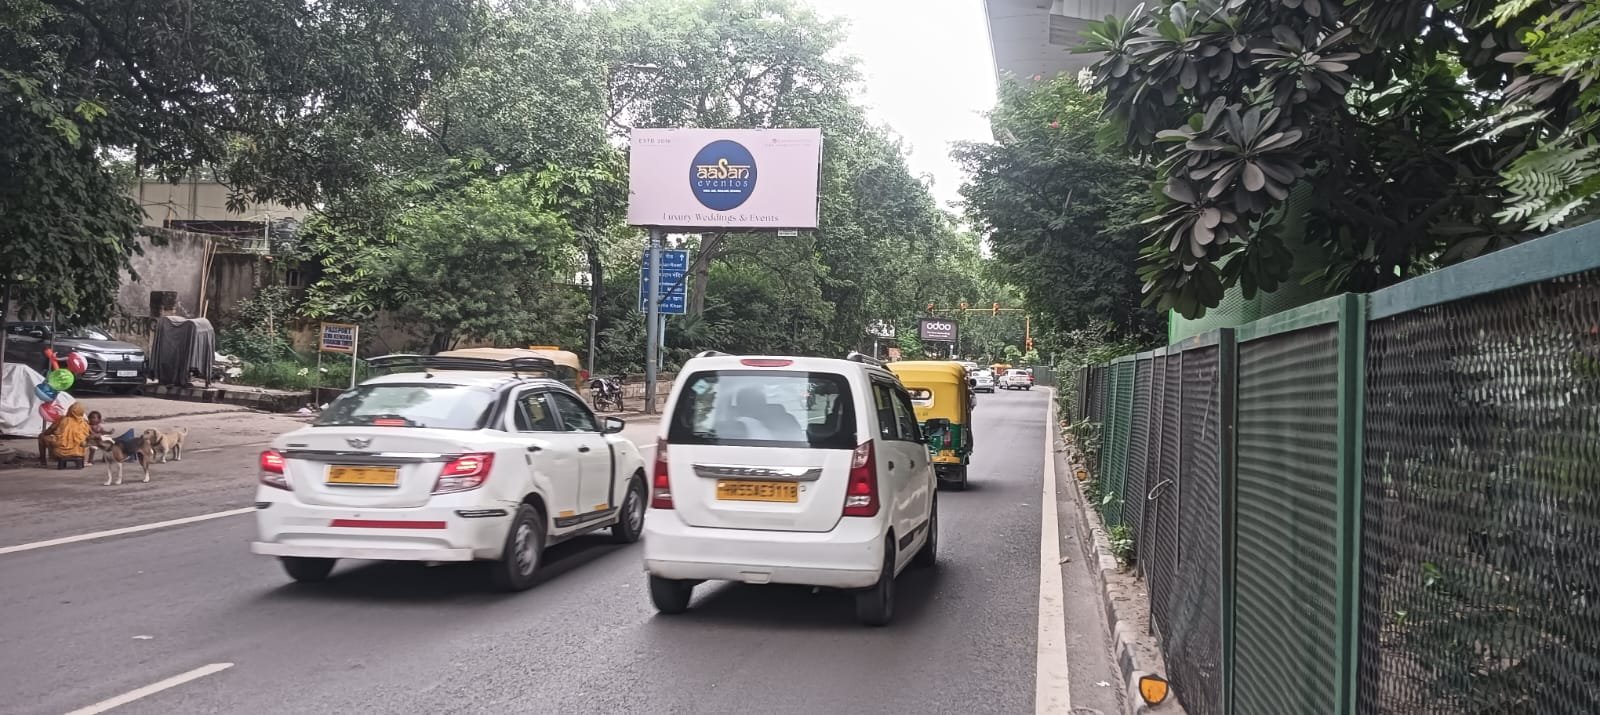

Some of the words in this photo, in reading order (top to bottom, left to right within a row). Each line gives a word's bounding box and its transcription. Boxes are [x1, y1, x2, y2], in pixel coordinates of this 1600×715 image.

[663, 212, 692, 223] Luxury
[695, 212, 737, 224] Weddings
[740, 214, 748, 222] &
[750, 214, 779, 222] Events
[325, 325, 352, 334] PASSPORT
[926, 321, 951, 330] odoo
